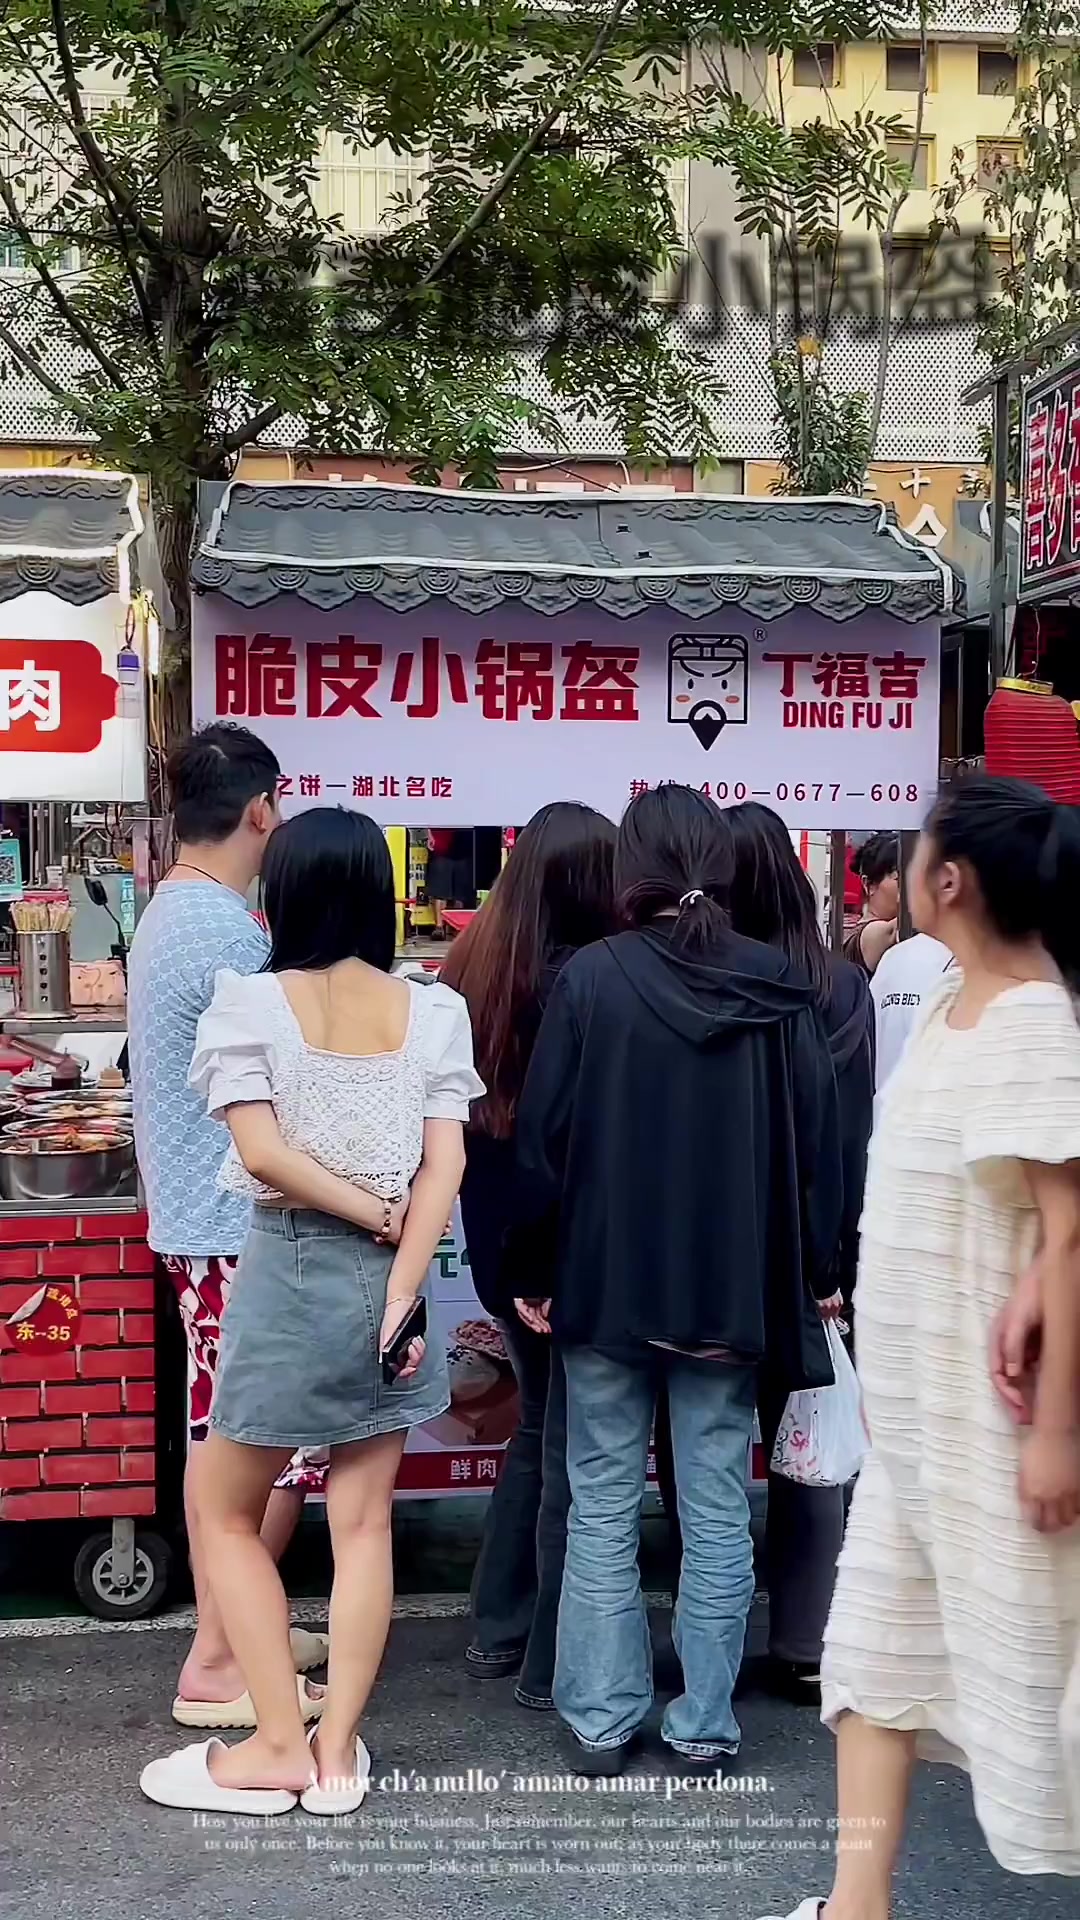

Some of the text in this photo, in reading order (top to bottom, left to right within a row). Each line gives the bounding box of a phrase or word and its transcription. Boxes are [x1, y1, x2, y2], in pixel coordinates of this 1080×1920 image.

[0, 659, 60, 732] 肉
[214, 633, 641, 722] 脆皮小锅盔
[762, 650, 927, 700] 丁福吉
[782, 700, 913, 729] DING FU JI
[450, 1459, 497, 1480] 鲜肉
